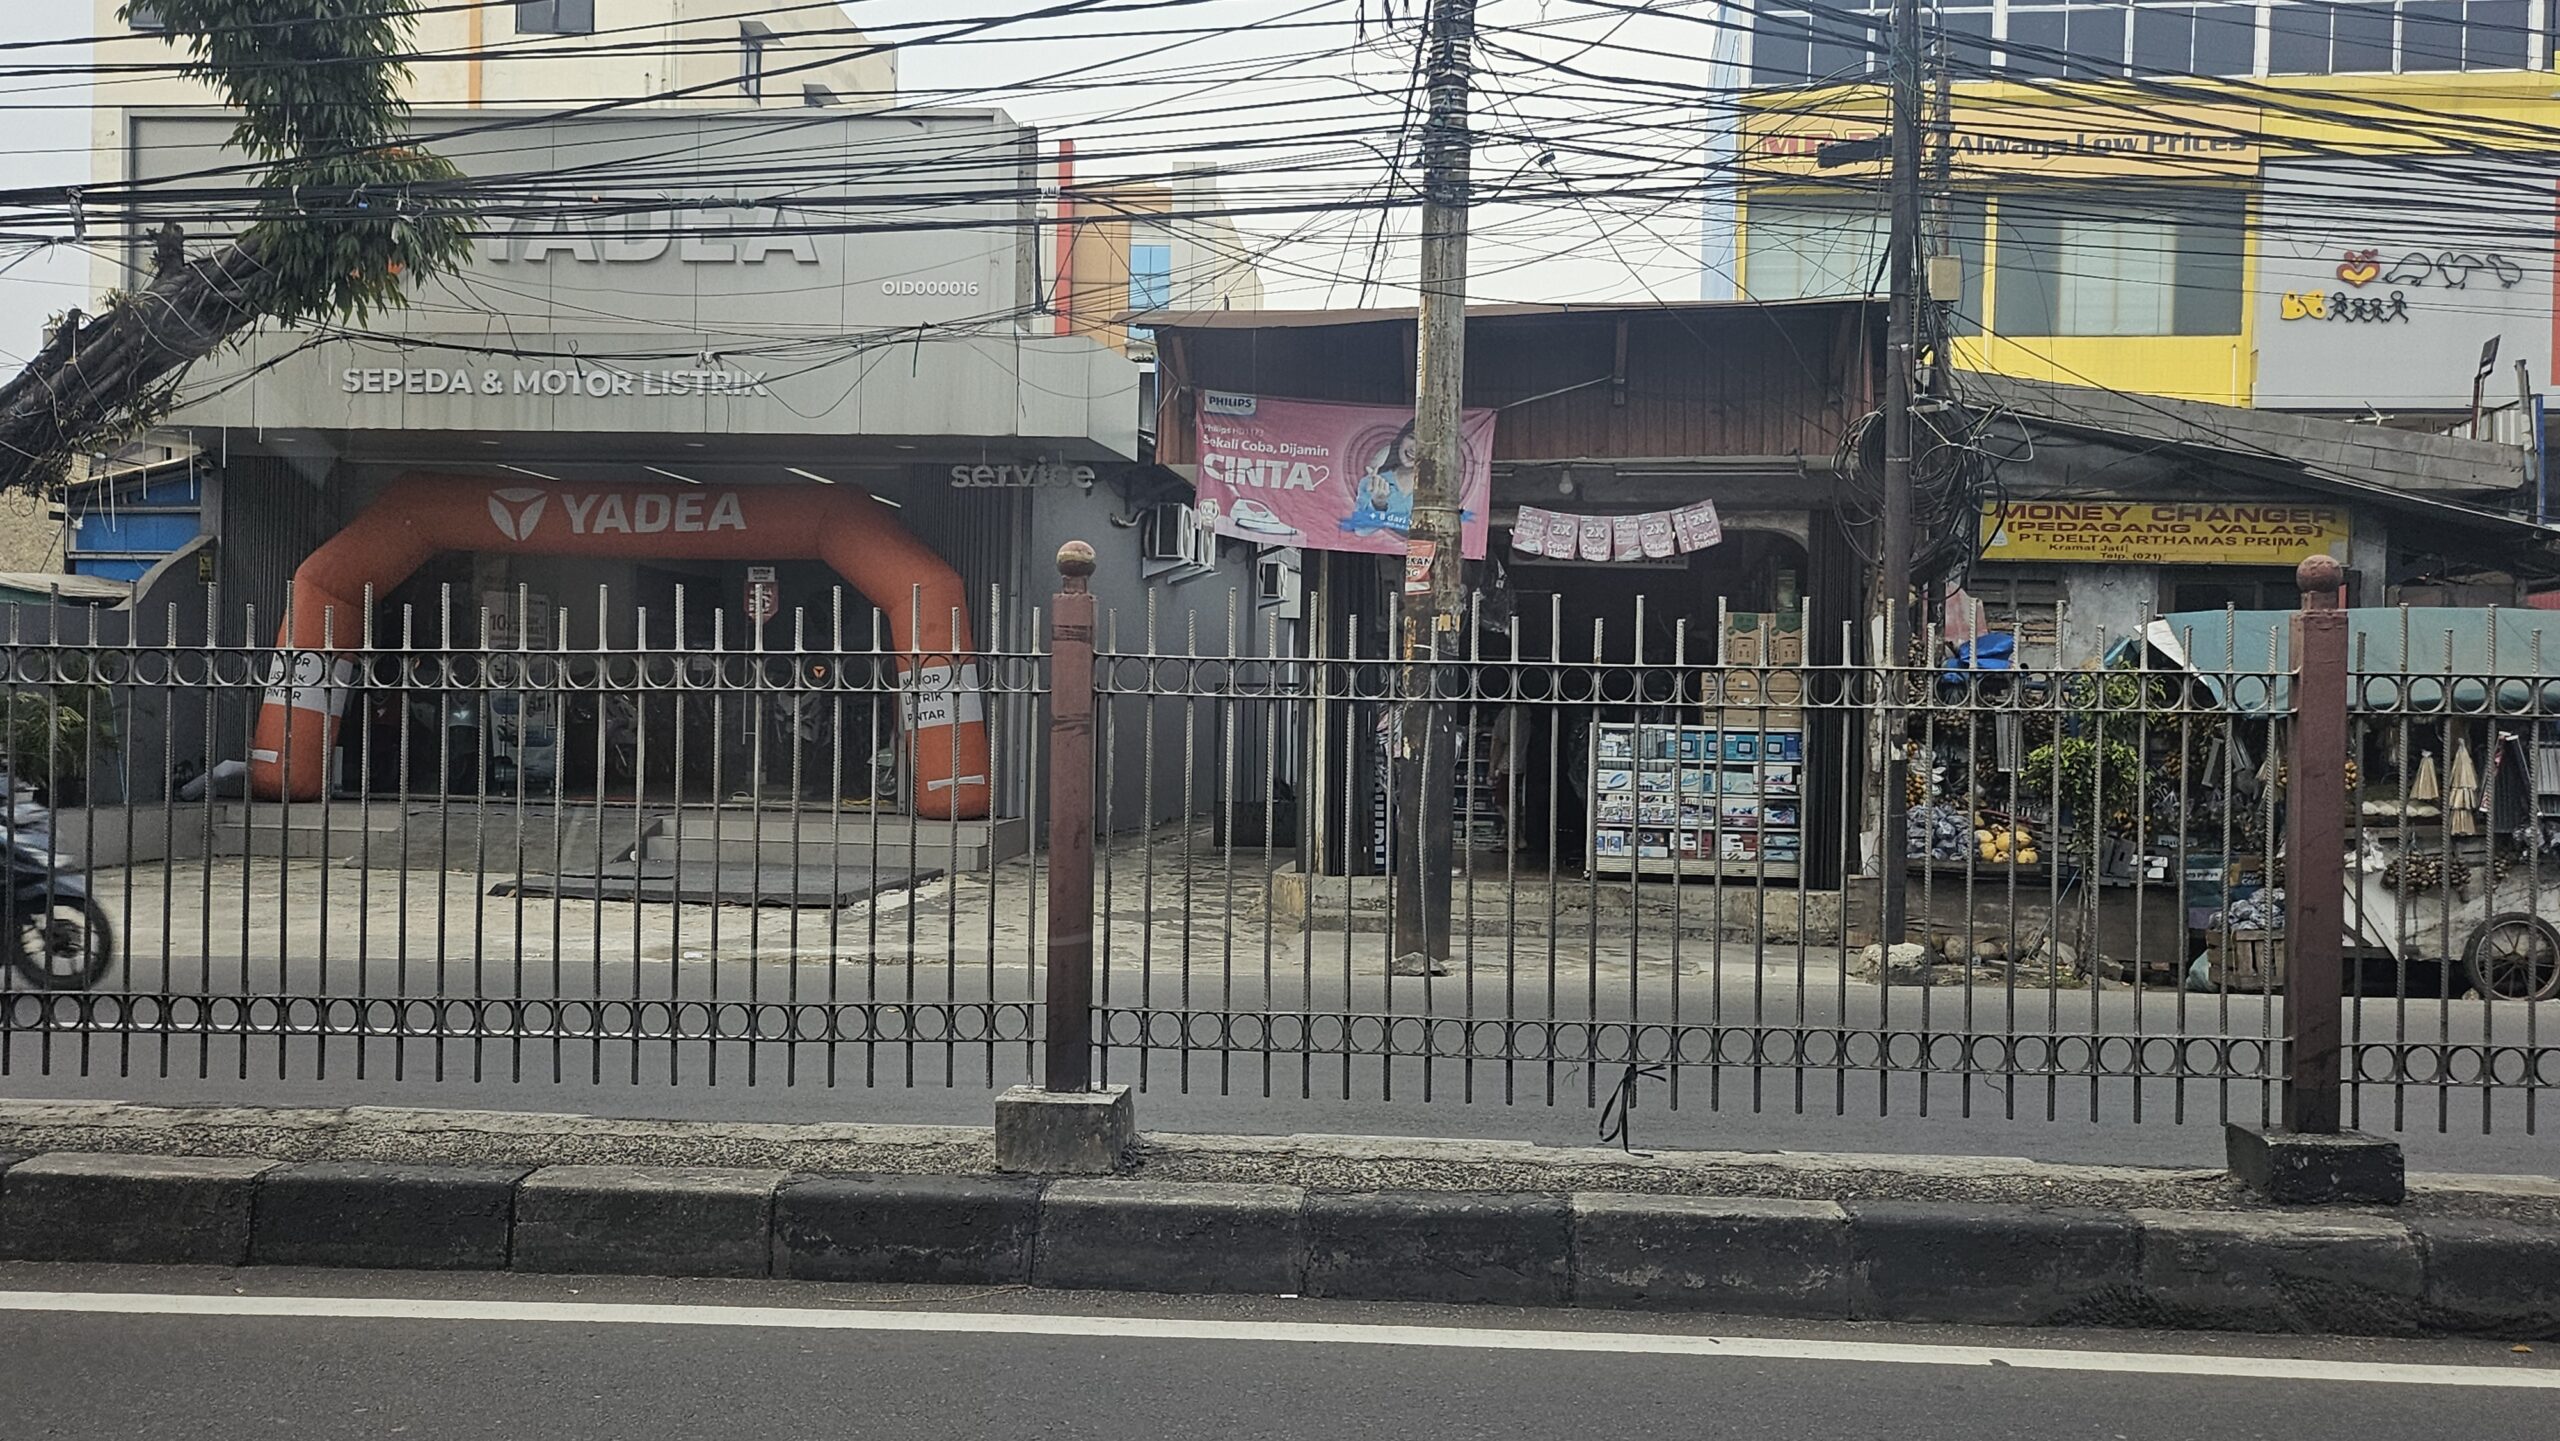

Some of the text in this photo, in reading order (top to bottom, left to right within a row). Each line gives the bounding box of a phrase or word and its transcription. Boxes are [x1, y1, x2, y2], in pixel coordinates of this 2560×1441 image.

[1951, 132, 2247, 159] Always Low Prices
[882, 281, 979, 296] OID000016
[342, 368, 768, 397] SEPEDA & MOTOR LISTRIK
[1208, 396, 1252, 408] PHILIPS
[1203, 434, 1329, 457] Sekali Coba, Dijamin
[951, 455, 1095, 489] service
[1203, 453, 1315, 491] CINTA
[562, 492, 747, 534] YADEA
[1689, 511, 1710, 527] 2X
[1995, 504, 2337, 524] MONEY CHANGER
[1552, 523, 1571, 537] 2X
[1585, 526, 1605, 538] 2X
[1645, 522, 1665, 536] 2X
[2018, 533, 2046, 543] PT.
[2052, 534, 2113, 544] DELTA
[2120, 535, 2237, 546] ARTHAMAS
[2244, 537, 2309, 547] PRIMA
[2049, 544, 2096, 552] Kramat
[2133, 552, 2162, 562] (021)
